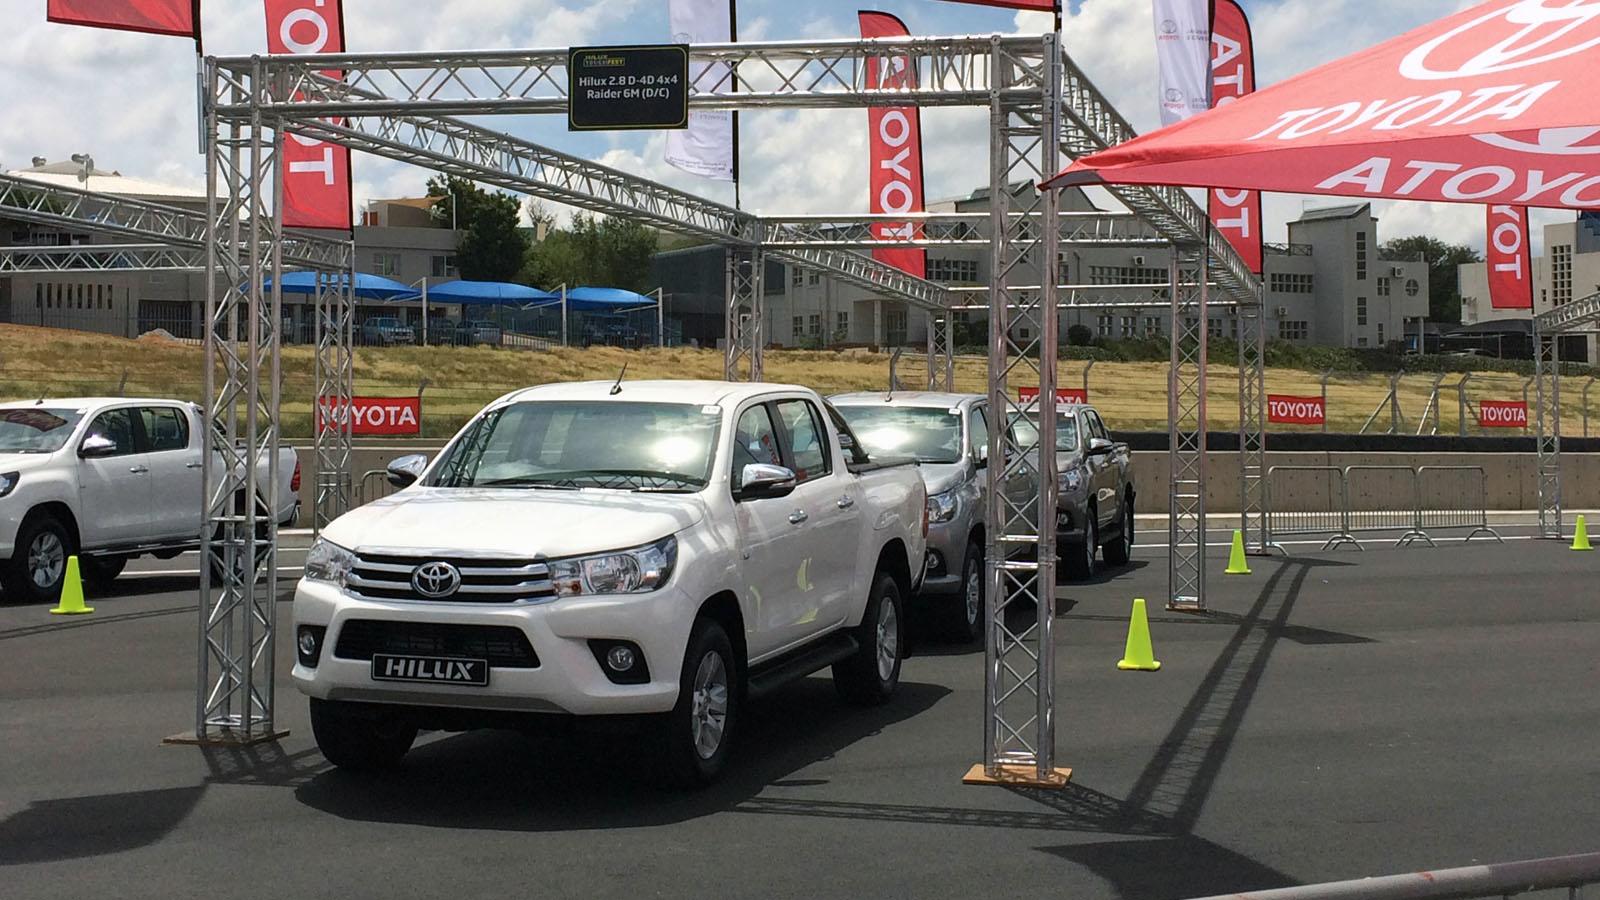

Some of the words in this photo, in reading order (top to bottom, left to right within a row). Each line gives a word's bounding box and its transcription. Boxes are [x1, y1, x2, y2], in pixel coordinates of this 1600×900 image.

[579, 77, 607, 87] Hilux
[608, 76, 626, 86] 2.8
[628, 75, 655, 85] D-4D
[656, 74, 678, 85] 4x4
[587, 89, 621, 99] Raider
[623, 88, 640, 98] 6M
[642, 88, 670, 100] (D/C)
[1244, 80, 1562, 142] TOYOTA
[1269, 401, 1324, 418] TOYOTA
[1481, 406, 1526, 421] TOYOTA
[385, 658, 475, 680] HILUX
